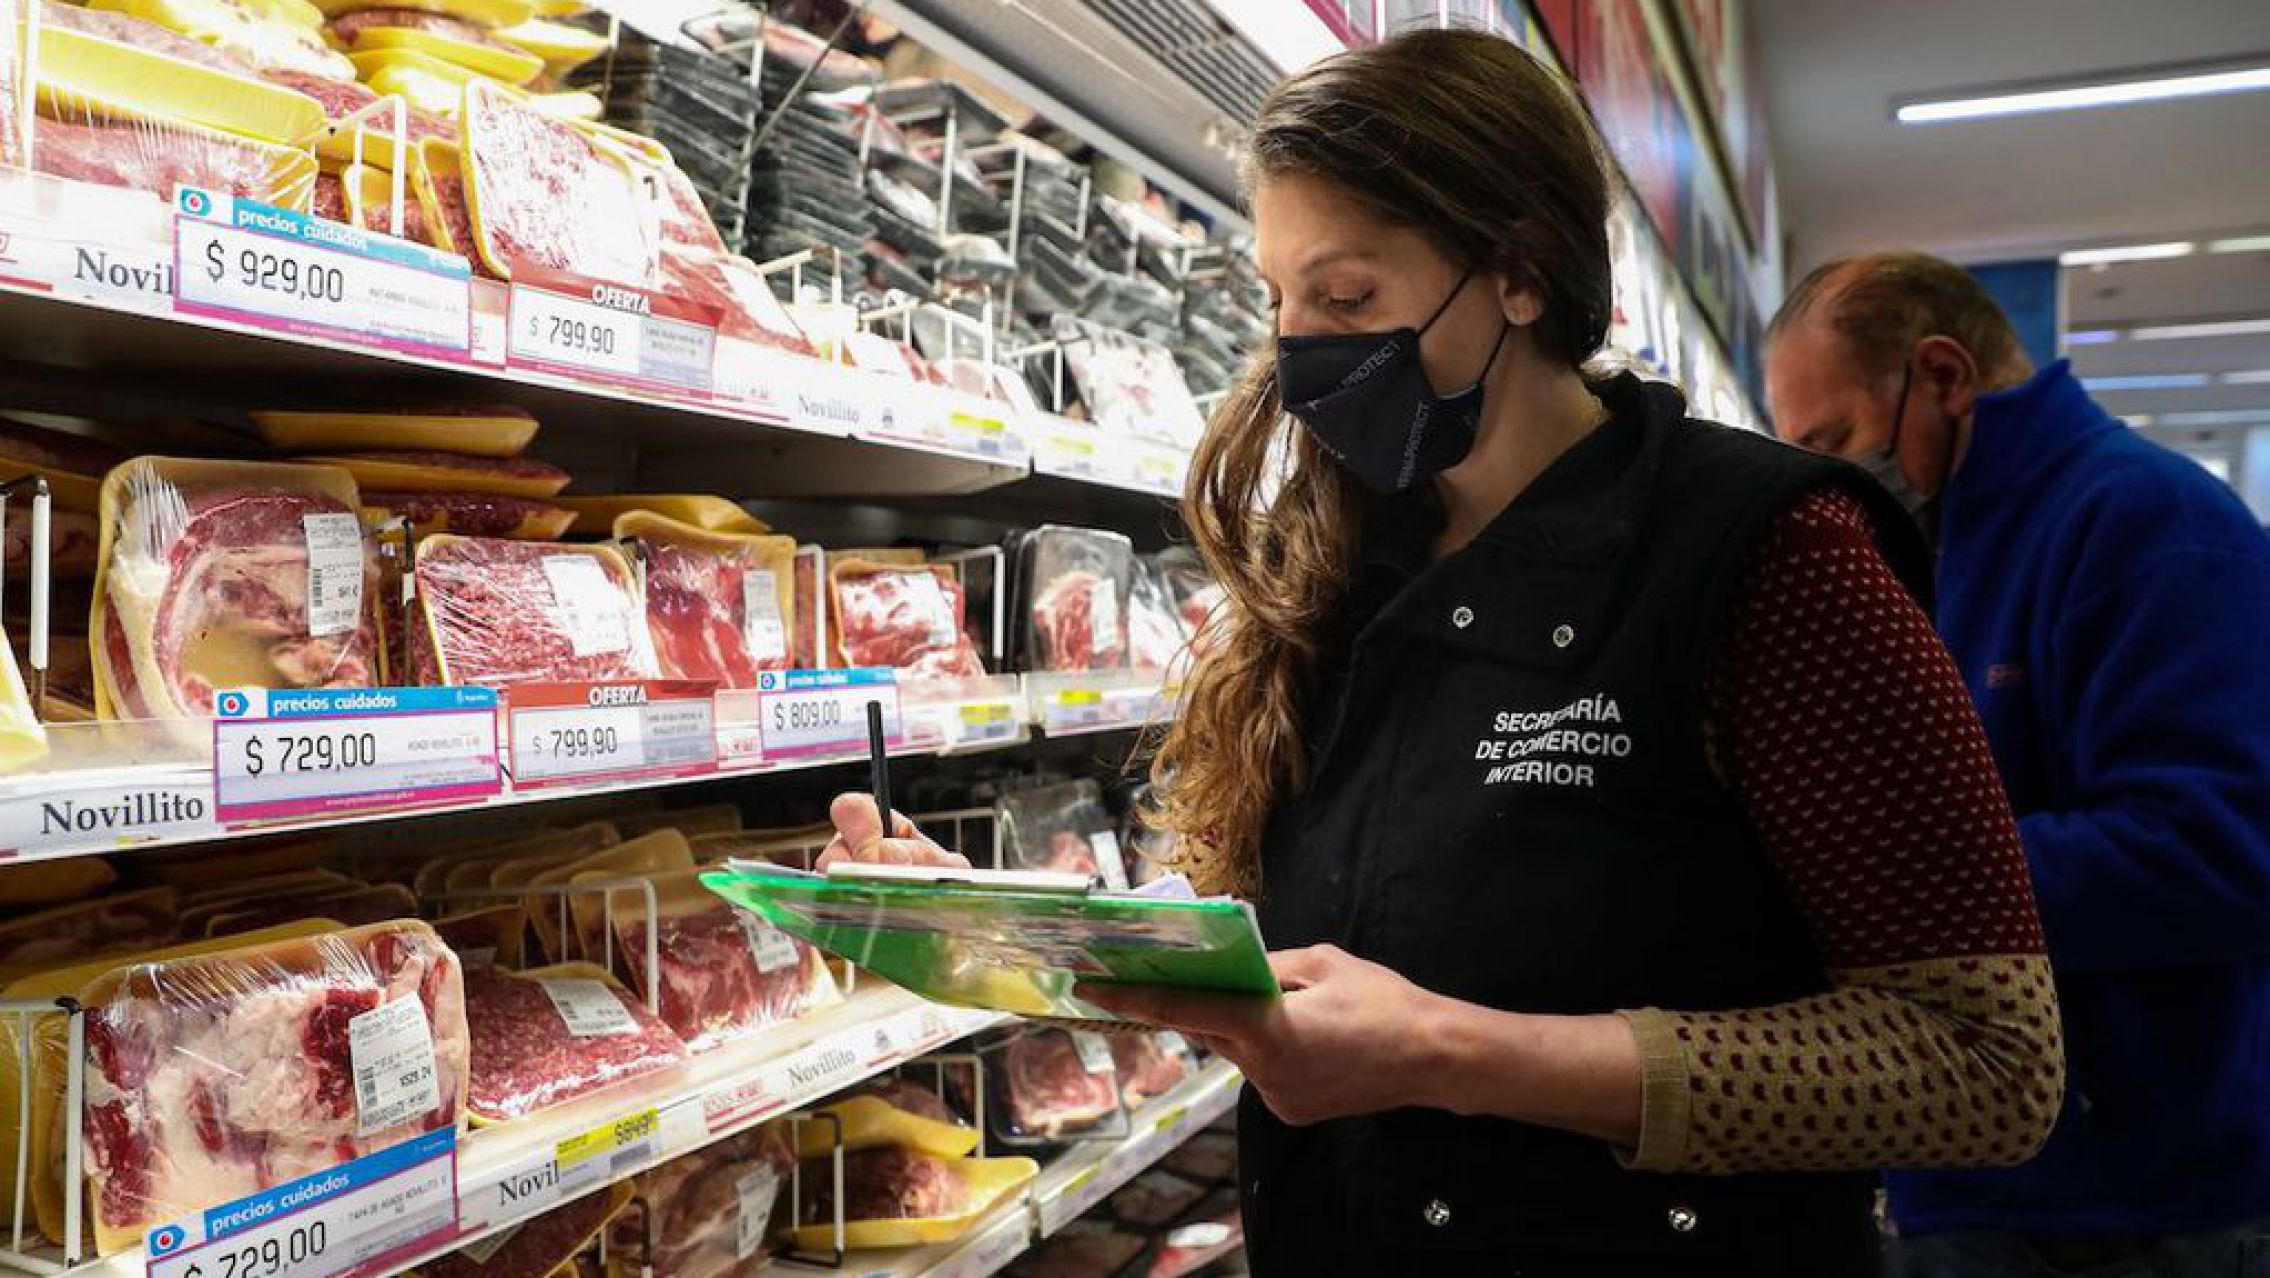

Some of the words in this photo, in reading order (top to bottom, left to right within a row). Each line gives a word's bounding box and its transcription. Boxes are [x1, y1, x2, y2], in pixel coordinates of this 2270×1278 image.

[238, 209, 298, 234] precios
[303, 222, 368, 250] cuidados
[206, 239, 225, 283] $
[240, 249, 344, 302] 929,00
[591, 284, 651, 315] OFERTA
[530, 316, 538, 337] $
[274, 697, 331, 714] precios
[335, 692, 397, 710] cuidados
[589, 684, 648, 707] OFERTA
[774, 702, 785, 732] $
[246, 735, 263, 779] $
[277, 732, 375, 773] 729,00
[533, 734, 542, 753] $
[1475, 739, 1508, 760] DE
[1507, 730, 1632, 759] COMERCIO
[1484, 760, 1594, 787] INTERIOR
[41, 791, 203, 834] Novillito
[212, 1202, 274, 1236] precios
[281, 1174, 350, 1208] cuidados
